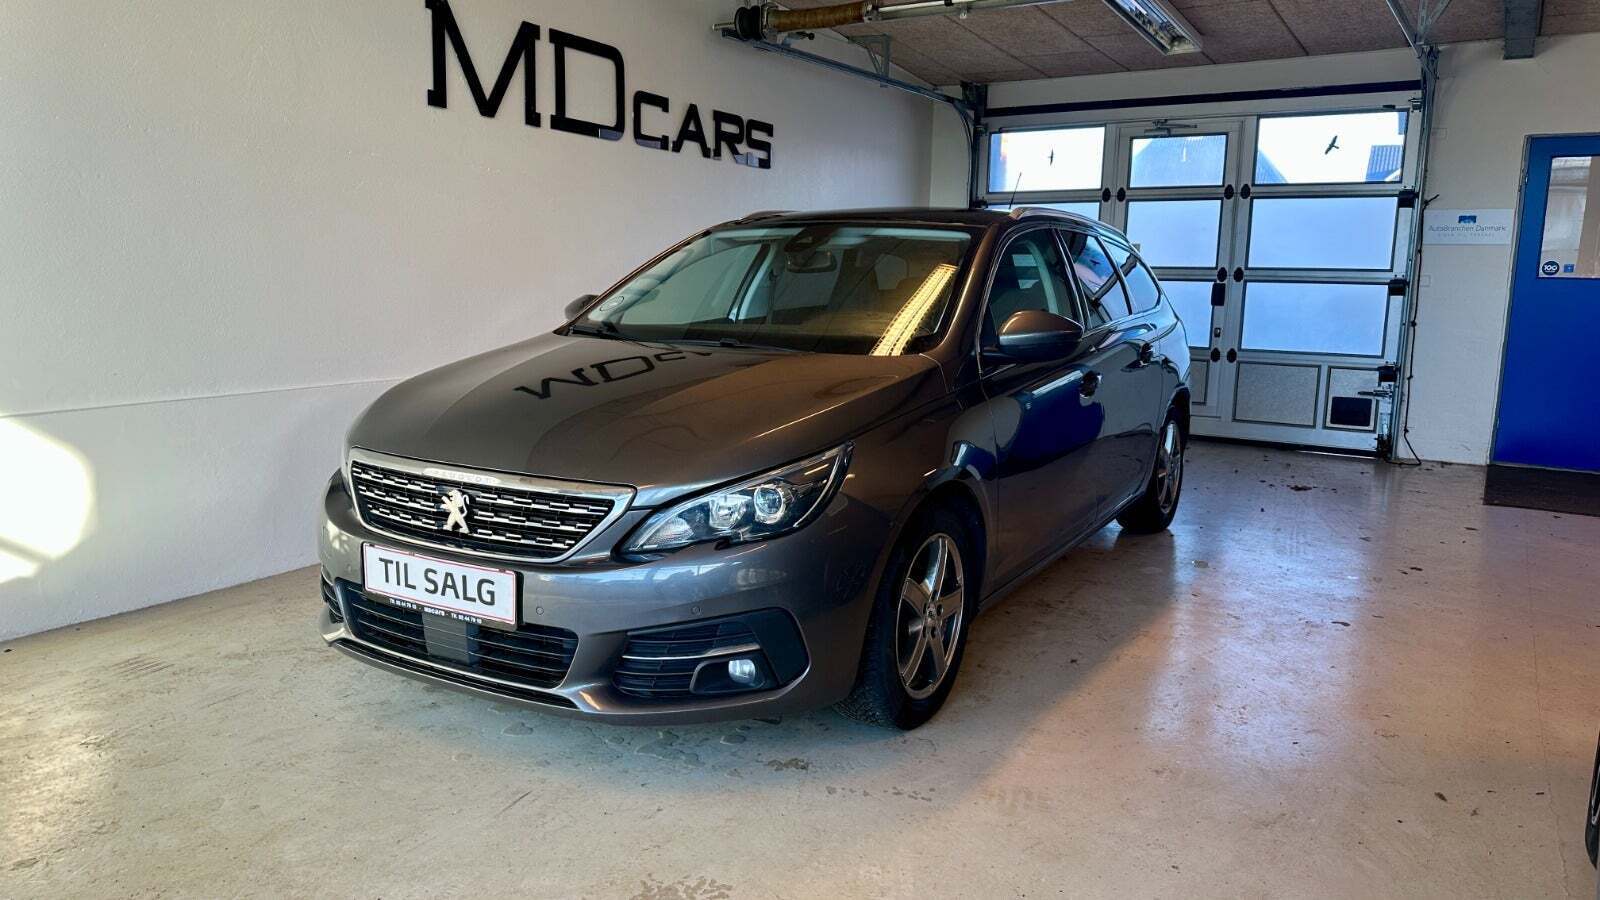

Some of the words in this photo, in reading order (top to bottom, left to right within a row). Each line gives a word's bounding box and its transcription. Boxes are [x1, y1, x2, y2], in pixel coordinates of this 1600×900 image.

[1476, 224, 1507, 232] Danmark
[378, 557, 417, 590] TIL
[424, 567, 496, 606] SALG
